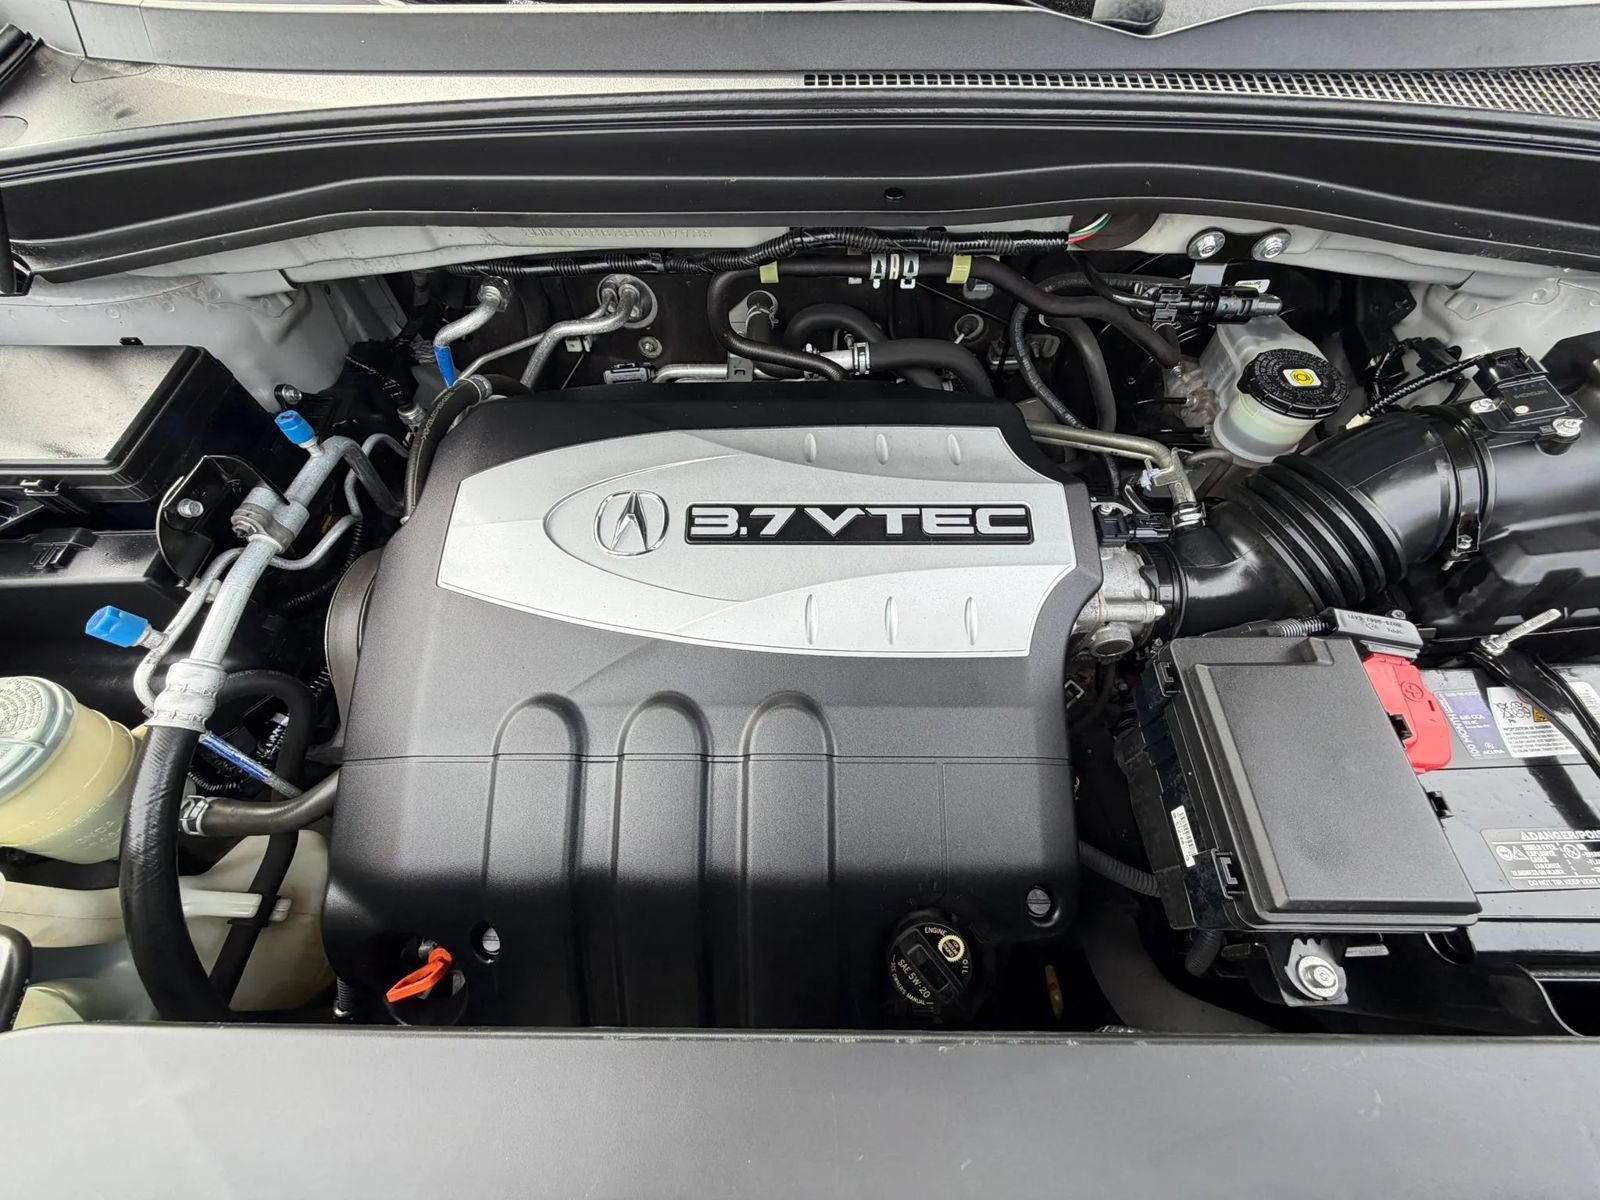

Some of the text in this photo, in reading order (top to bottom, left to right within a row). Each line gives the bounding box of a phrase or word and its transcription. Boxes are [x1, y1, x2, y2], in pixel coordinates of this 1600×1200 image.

[924, 926, 947, 937] ENGINE
[961, 959, 969, 974] OIL
[898, 958, 931, 998] SAE 5W-20
[906, 992, 926, 1006] MANUAL
